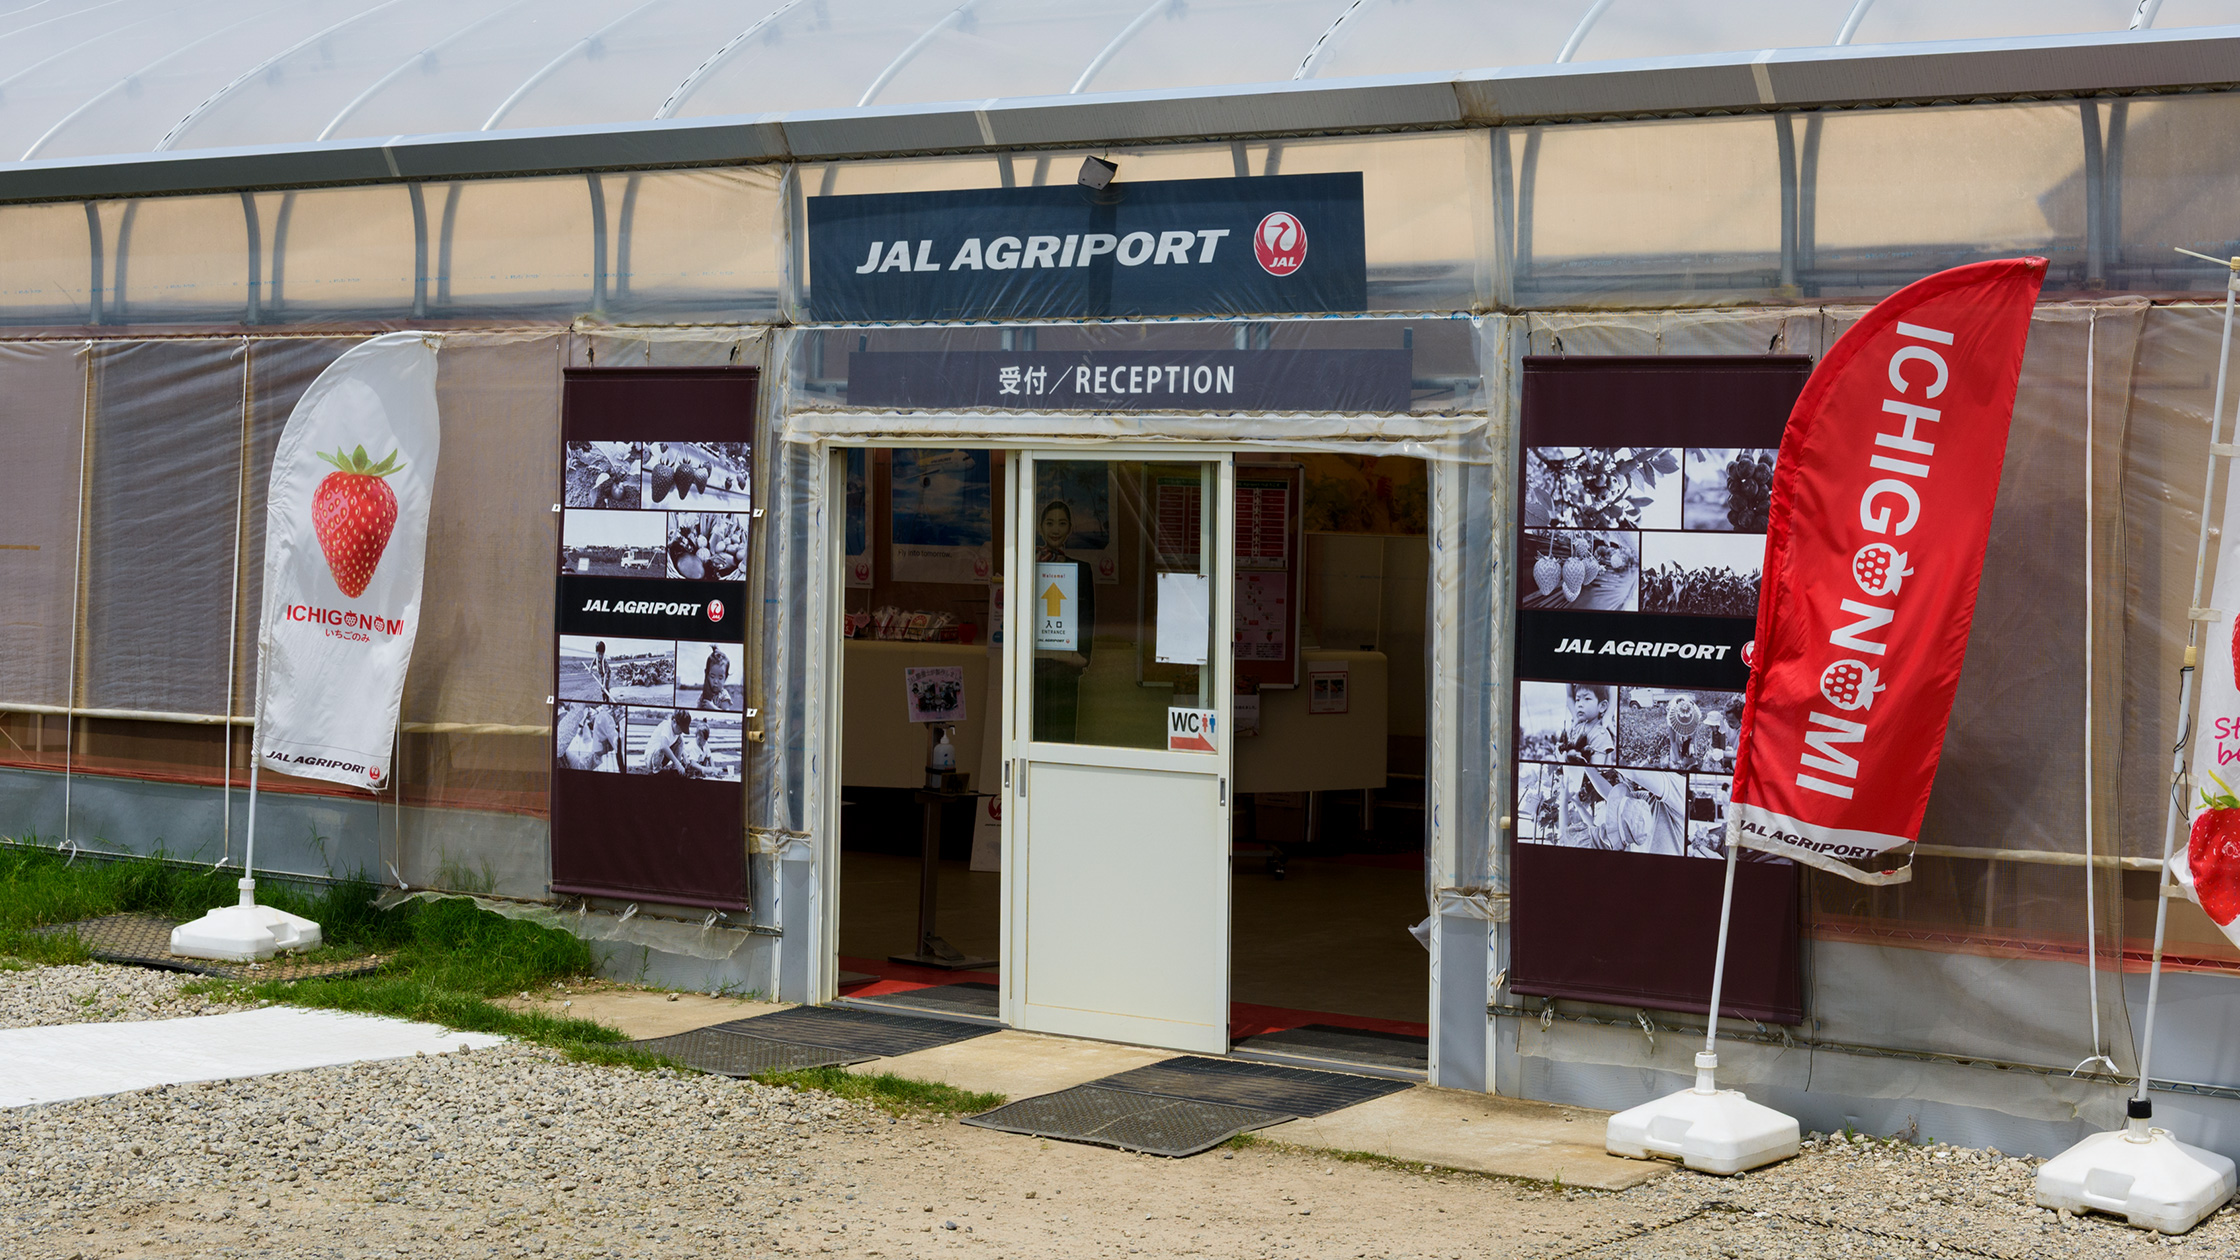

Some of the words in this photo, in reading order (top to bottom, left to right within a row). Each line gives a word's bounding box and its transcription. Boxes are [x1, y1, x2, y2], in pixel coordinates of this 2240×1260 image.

[856, 239, 941, 274] JAL
[949, 229, 1230, 271] AGRIPORT
[1269, 256, 1298, 269] JAL
[582, 599, 611, 613] JAL
[612, 600, 702, 616] AGRIPORT
[325, 627, 372, 643] いちごのみ
[1045, 620, 1063, 628] 入口
[1554, 638, 1595, 654] JAL
[1598, 640, 1731, 660] AGRIPORT
[1171, 711, 1200, 733] WC
[266, 750, 291, 764] JAL
[293, 755, 366, 775] AGRIPORT
[1769, 830, 1879, 858] AGRIPORT
